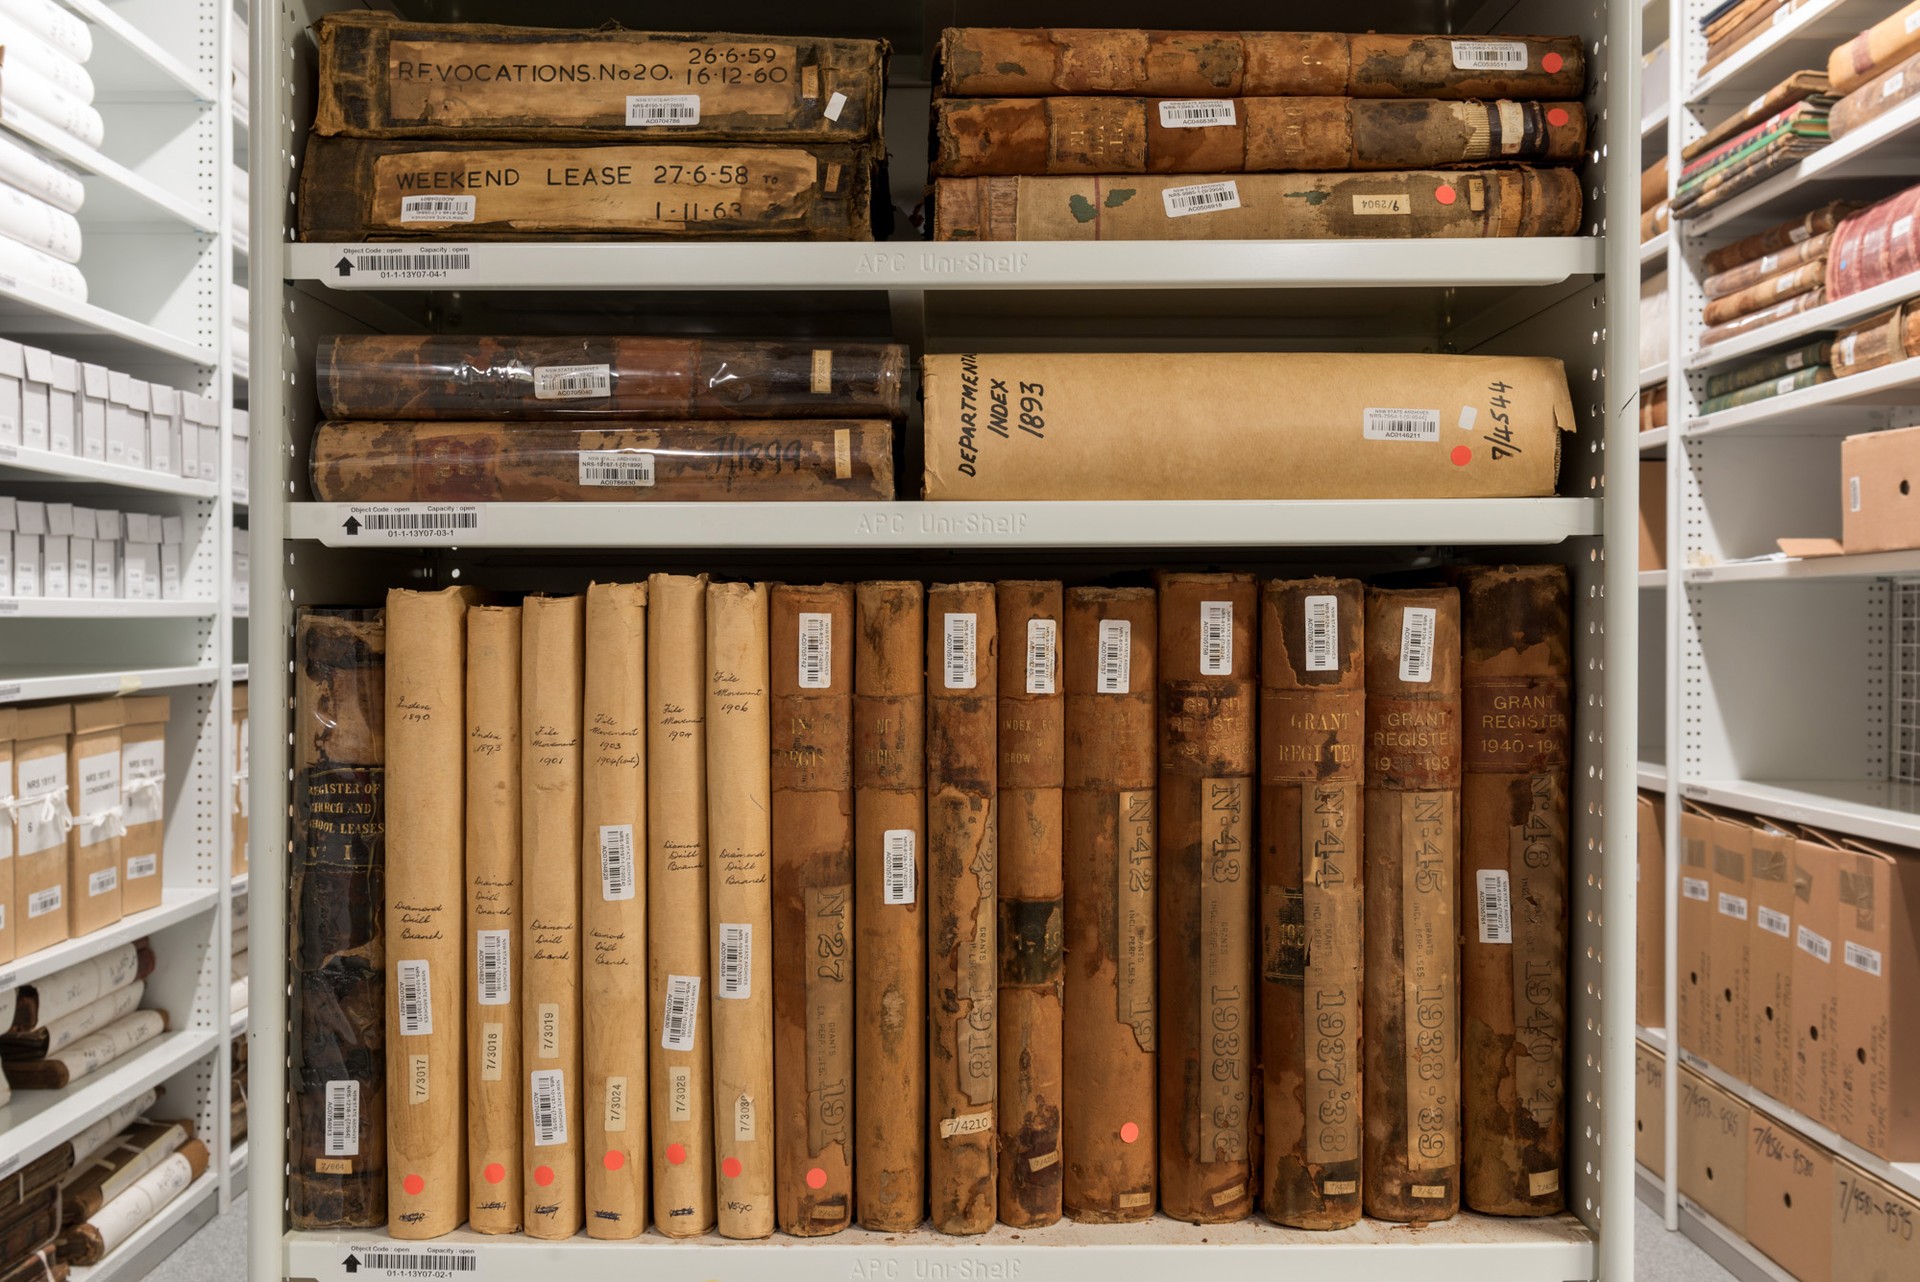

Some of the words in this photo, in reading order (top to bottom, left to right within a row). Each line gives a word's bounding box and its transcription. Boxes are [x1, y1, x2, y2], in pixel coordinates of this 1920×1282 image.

[396, 168, 520, 190] WEEKEND
[547, 166, 632, 186] LEASE
[1361, 199, 1400, 212] 9/2904
[856, 252, 905, 273] APC
[987, 378, 1009, 438] INDEX
[1018, 381, 1044, 438] 1893
[855, 513, 905, 534] APC
[402, 713, 430, 722] 1890
[721, 701, 749, 714] 1906
[1291, 711, 1350, 731] GRANT
[1388, 712, 1447, 727] GRANT
[476, 744, 502, 755] 1893
[599, 741, 622, 751] 1903
[539, 757, 564, 766] 1901
[308, 783, 360, 796] REGISTER
[364, 783, 380, 794] OF
[340, 823, 384, 834] LEASES
[979, 927, 987, 961] GRANTS
[1424, 922, 1434, 956] GRANTS
[665, 994, 673, 1029] AC0704830
[544, 1012, 554, 1050] 7/3019
[486, 1033, 497, 1070] 7/3018
[416, 1059, 426, 1096] 7/3017
[611, 1084, 621, 1121] 7/3024
[676, 1075, 686, 1112] 7/3026
[947, 1117, 988, 1133] 7/4210
[387, 1270, 453, 1278] 01-1-13Y07-02-1
[850, 1257, 899, 1280] APC
